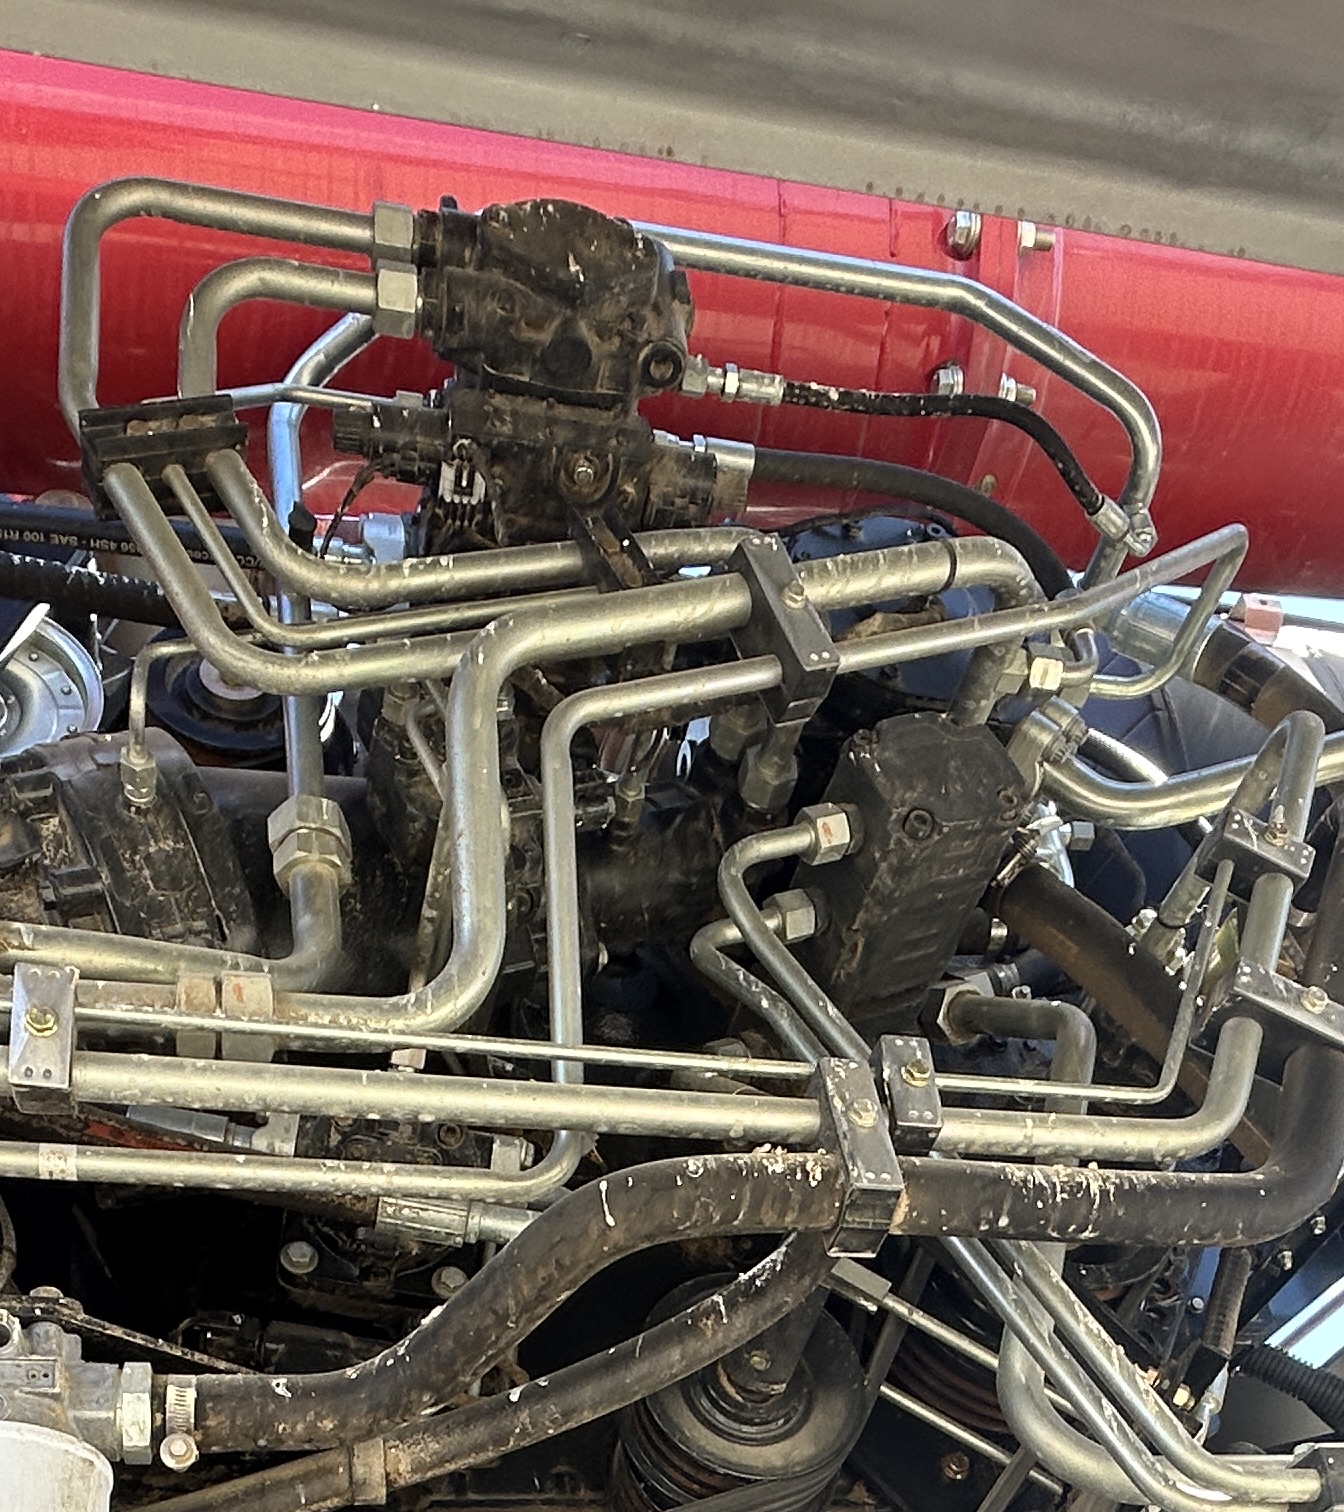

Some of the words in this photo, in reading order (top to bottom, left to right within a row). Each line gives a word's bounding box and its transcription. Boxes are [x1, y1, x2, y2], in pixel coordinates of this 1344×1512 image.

[22, 531, 44, 543] 100
[50, 533, 78, 547] SAE
[91, 538, 118, 551] 4SH
